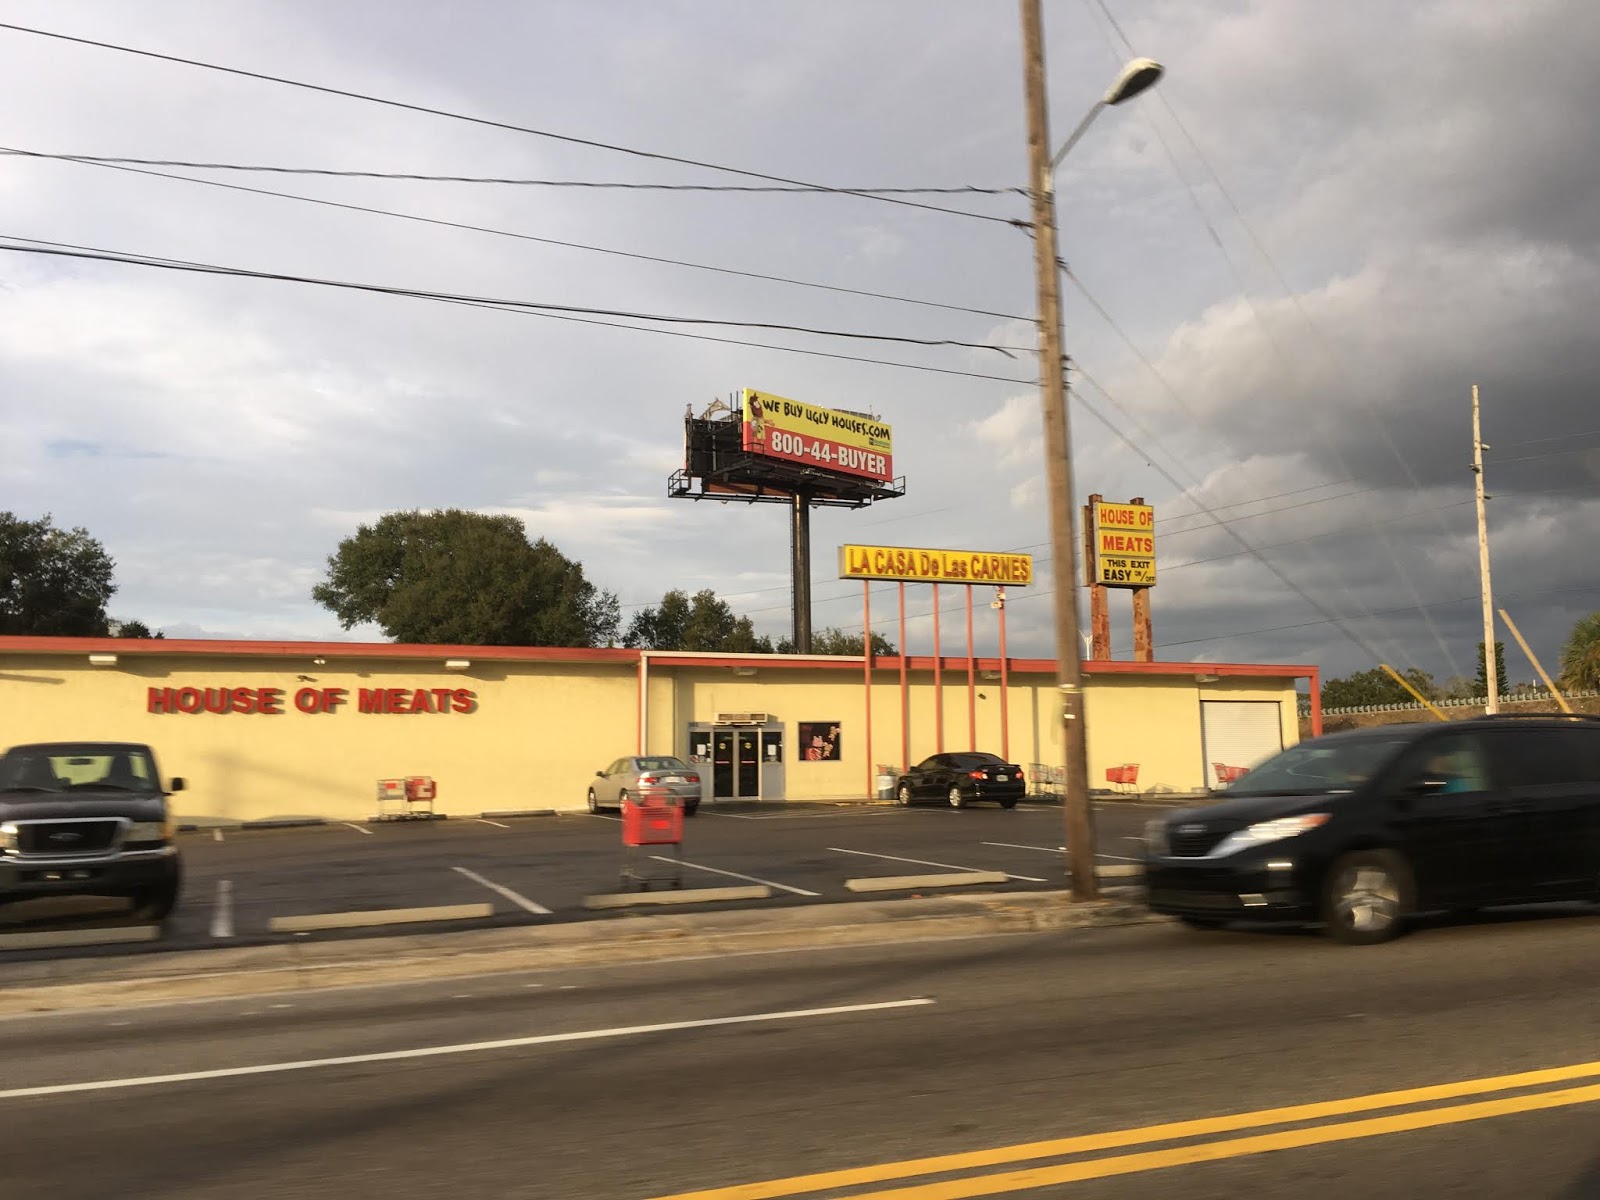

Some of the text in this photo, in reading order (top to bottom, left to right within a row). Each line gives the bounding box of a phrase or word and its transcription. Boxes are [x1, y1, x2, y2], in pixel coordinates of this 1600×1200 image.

[762, 400, 780, 412] WE
[784, 402, 803, 418] BUY
[806, 409, 829, 425] UGLY
[771, 431, 886, 475] 800-44-BUYER
[1100, 508, 1154, 526] HOUSE OF
[1103, 535, 1153, 553] MEATS
[849, 548, 1029, 581] LA CASA De Las CARNES
[1107, 559, 1151, 569] THIS EXIT
[1103, 568, 1132, 582] EASY
[147, 686, 476, 714] HOUSE OF MEATS
